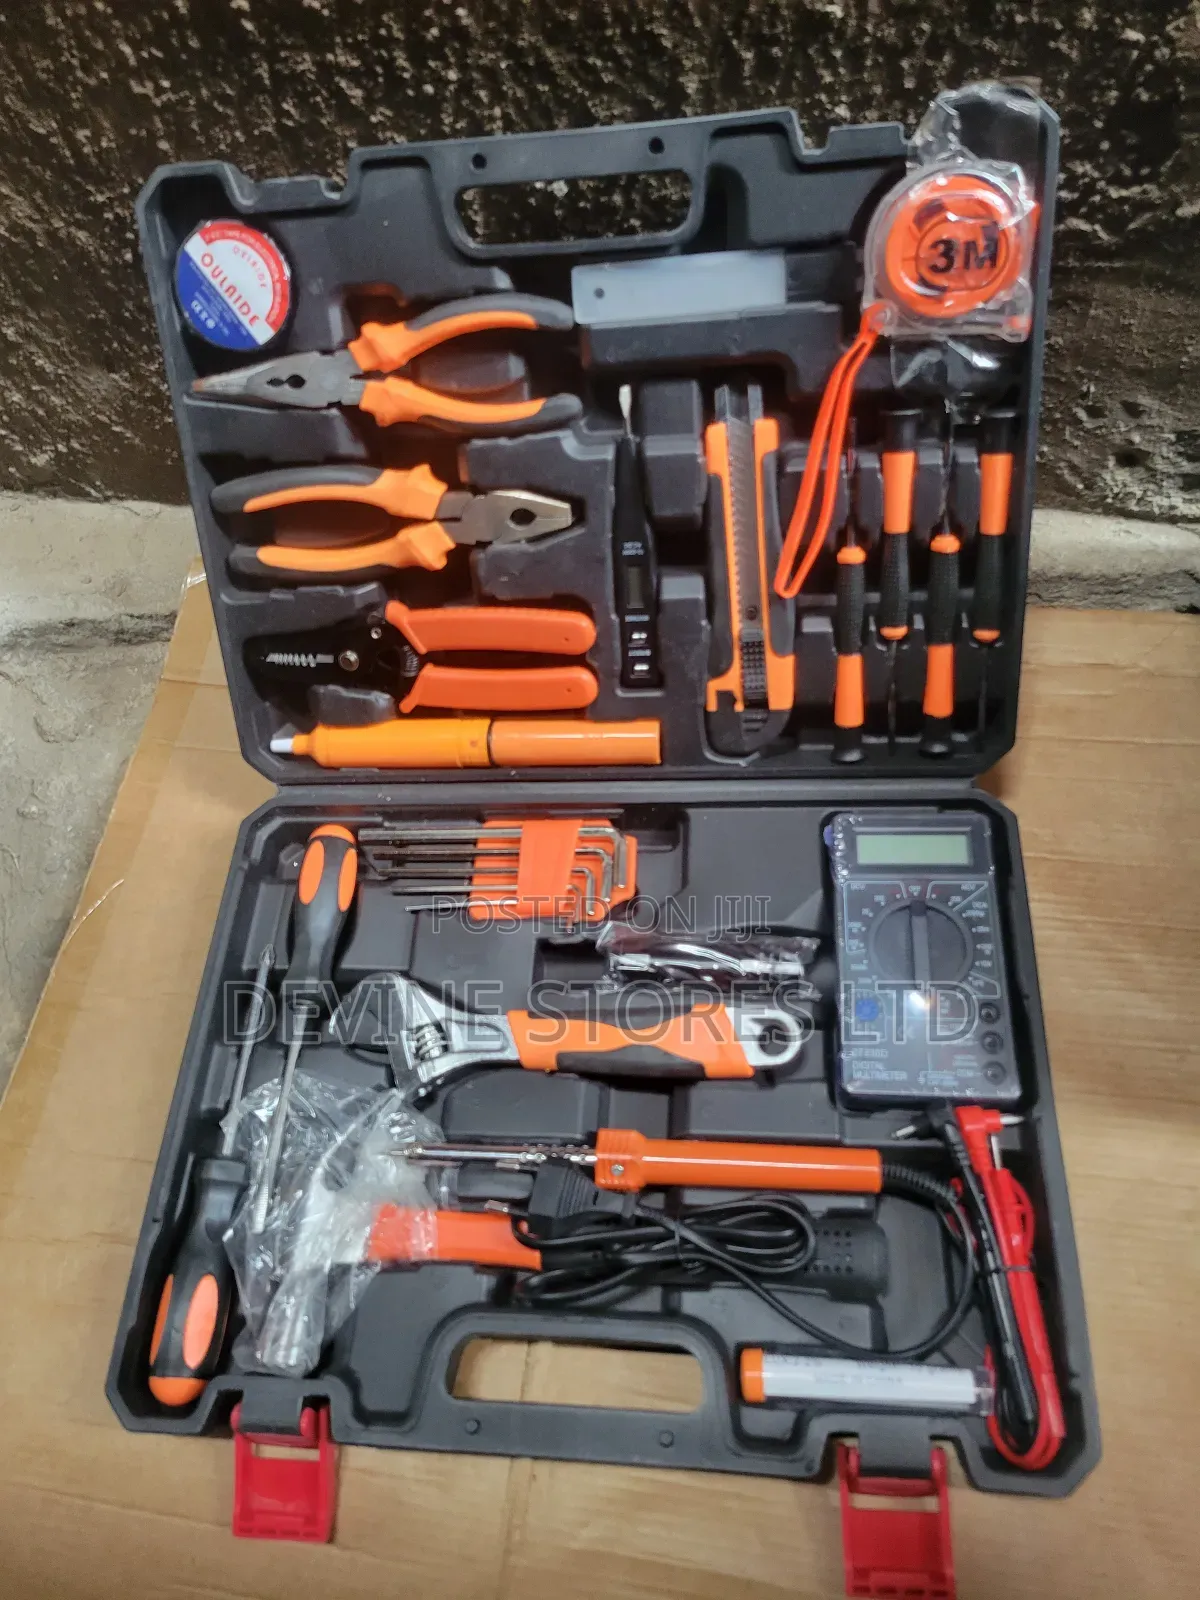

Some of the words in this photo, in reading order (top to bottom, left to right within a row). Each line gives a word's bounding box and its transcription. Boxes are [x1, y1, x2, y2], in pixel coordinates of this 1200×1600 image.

[929, 236, 998, 274] 3M
[201, 252, 260, 327] OULAIDE
[852, 1060, 885, 1070] DIGITAL
[852, 1071, 908, 1081] MULTIMETER
